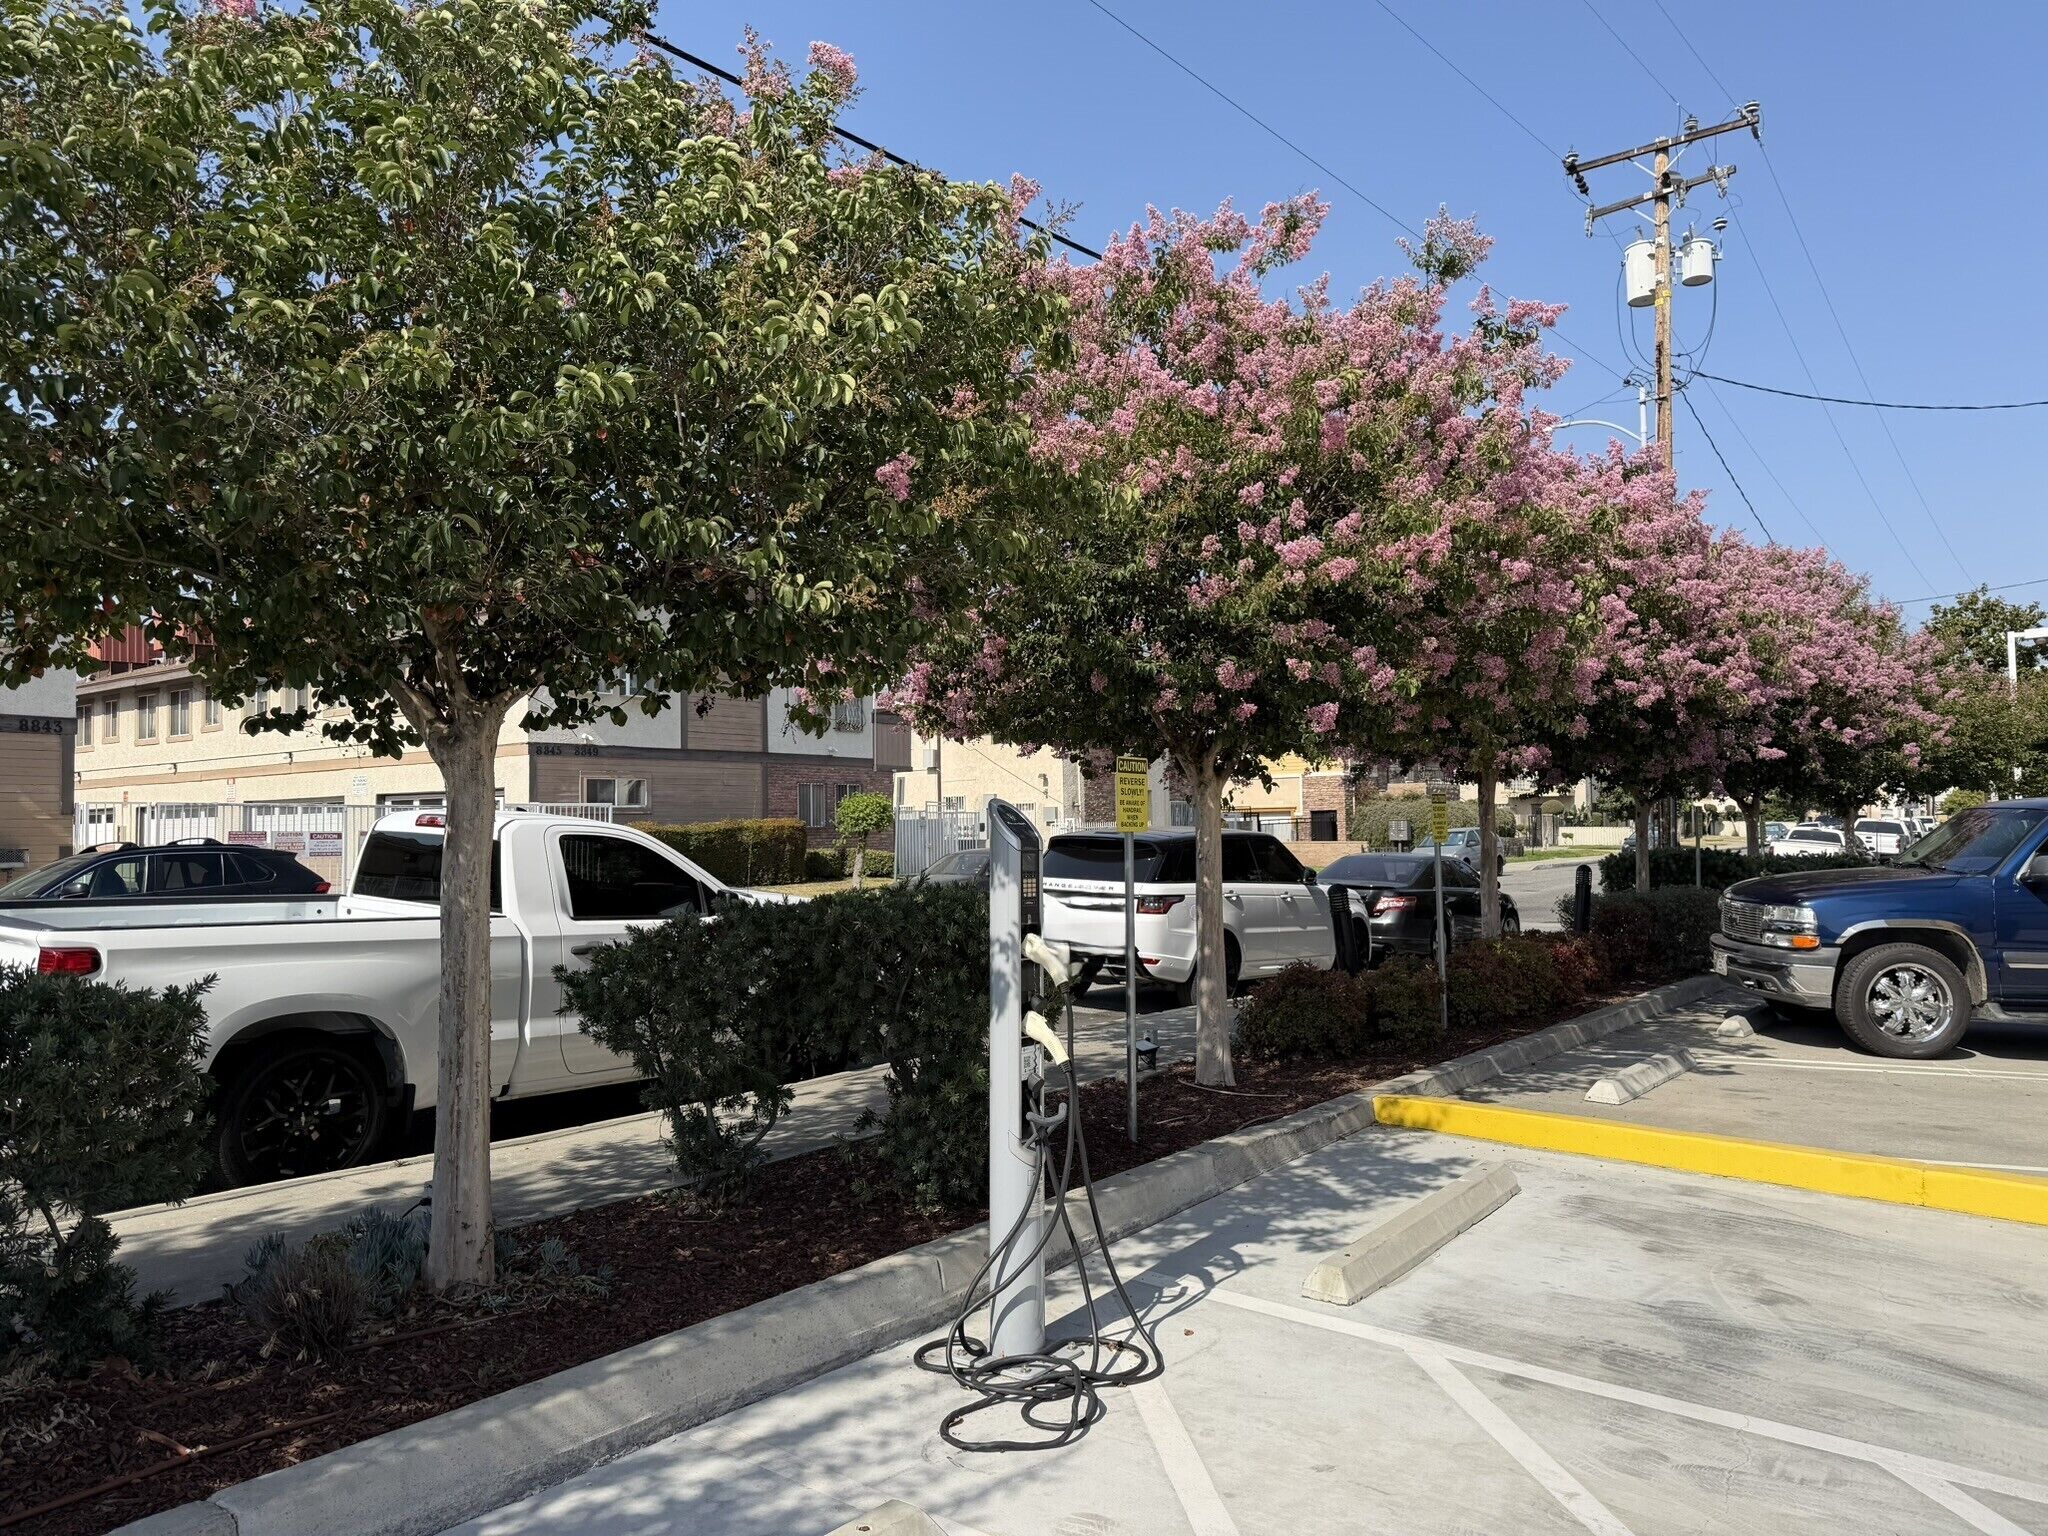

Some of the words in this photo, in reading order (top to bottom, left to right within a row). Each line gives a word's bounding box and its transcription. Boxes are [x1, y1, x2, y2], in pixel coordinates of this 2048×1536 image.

[20, 718, 63, 734] 8843
[536, 745, 561, 755] 8845
[574, 746, 598, 757] 8849
[1119, 760, 1146, 772] CAUTION
[1120, 777, 1145, 786] REVERSE
